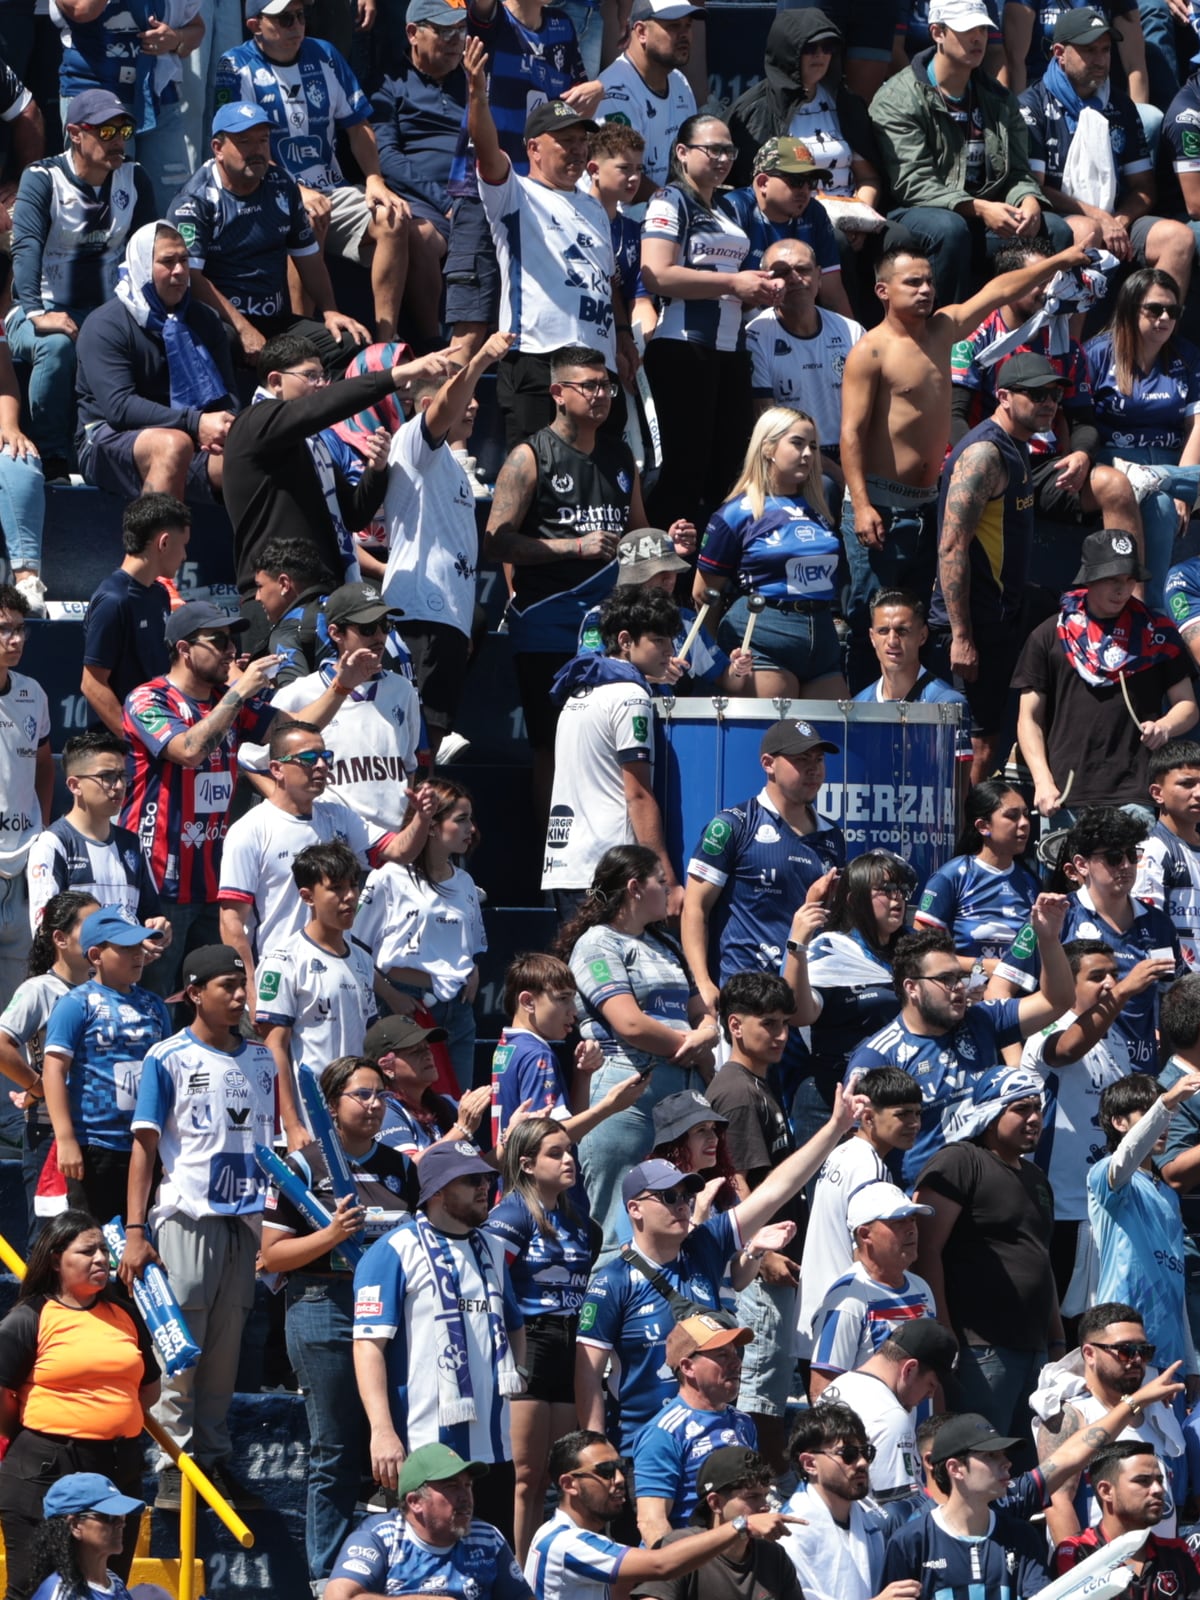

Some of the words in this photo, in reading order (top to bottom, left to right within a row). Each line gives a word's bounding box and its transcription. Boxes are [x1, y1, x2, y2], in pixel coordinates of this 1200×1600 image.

[557, 504, 621, 525] Distrito
[328, 755, 407, 788] SAMSUN
[212, 783, 231, 801] BN
[817, 782, 946, 826] UERZA
[547, 827, 570, 842] KING
[1127, 1039, 1153, 1064] ölbi
[225, 1088, 248, 1099] FAW
